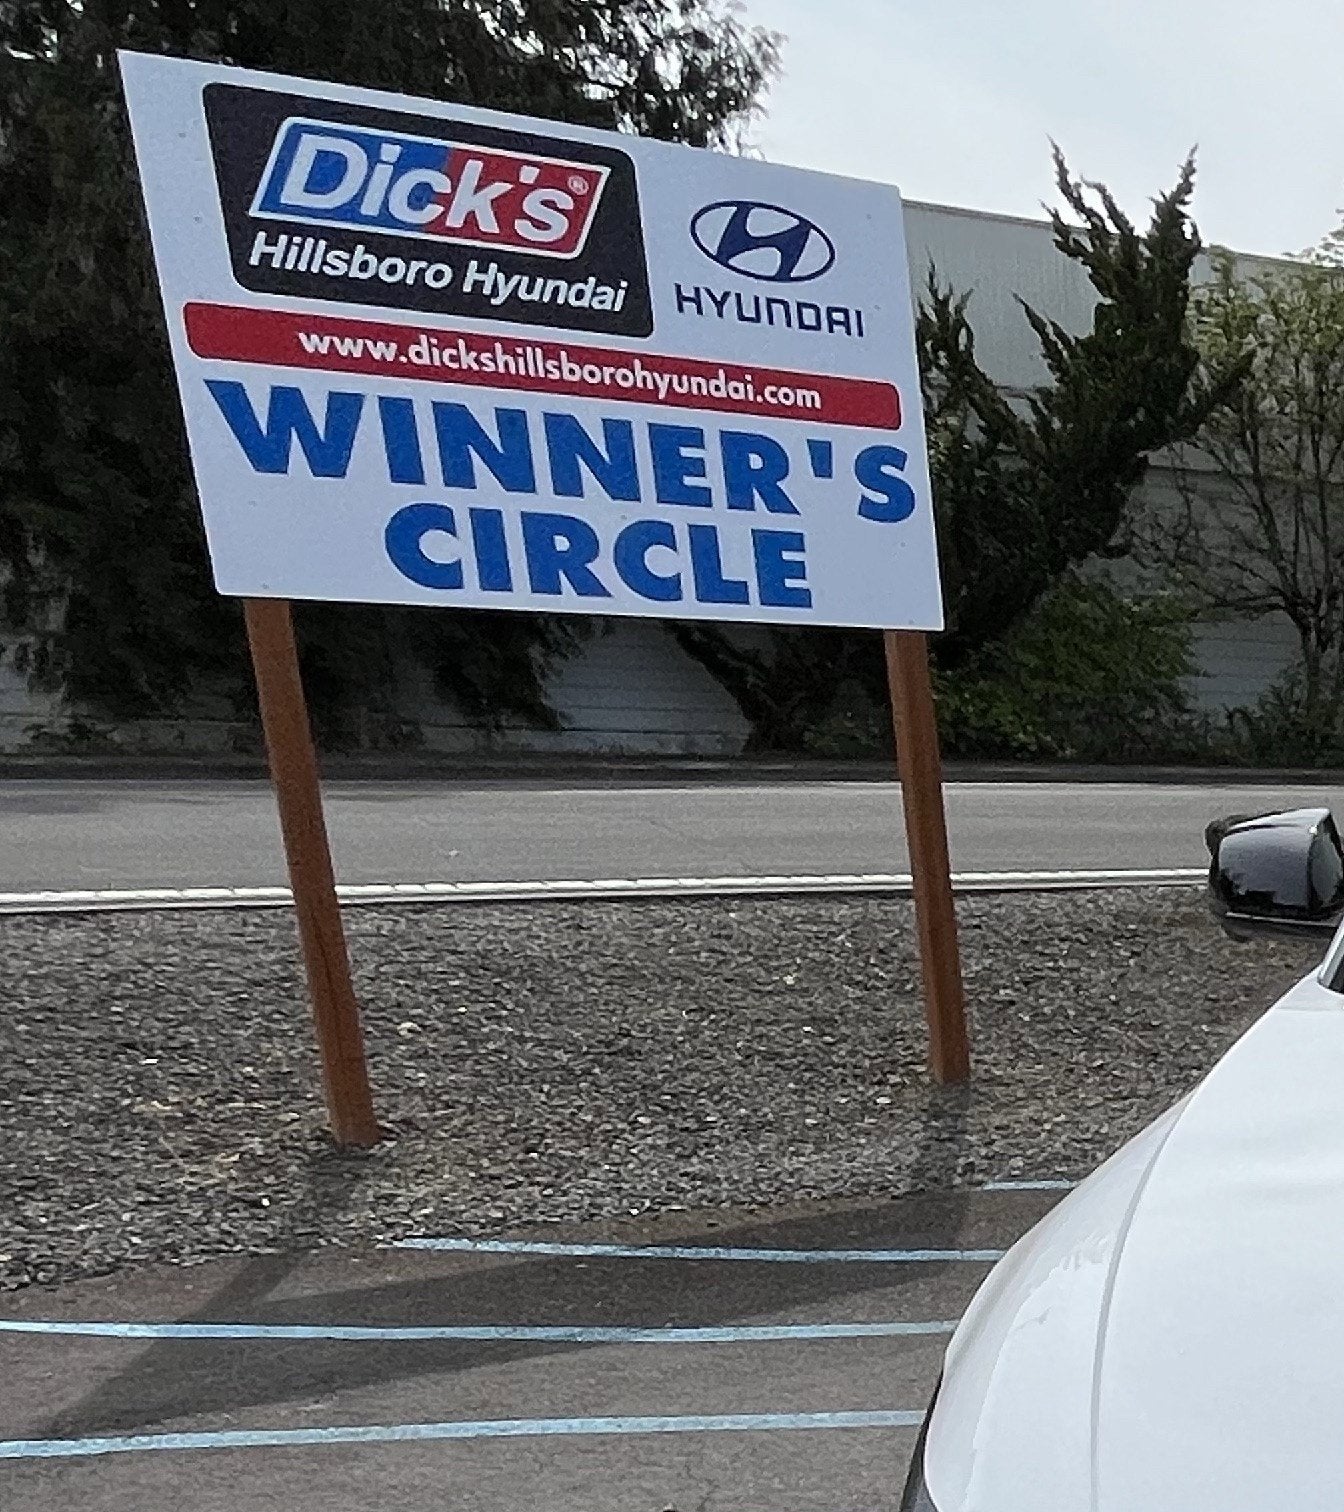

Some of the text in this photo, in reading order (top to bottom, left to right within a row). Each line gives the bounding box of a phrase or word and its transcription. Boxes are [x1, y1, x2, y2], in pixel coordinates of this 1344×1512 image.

[280, 133, 574, 243] Dick's
[249, 230, 629, 313] Hillsboro Hyundai
[674, 282, 865, 338] HYUNDAI
[297, 329, 822, 411] www.dickshillsborohyundai.com
[203, 378, 917, 523] WINNER'S
[384, 501, 813, 608] CIRCLE
